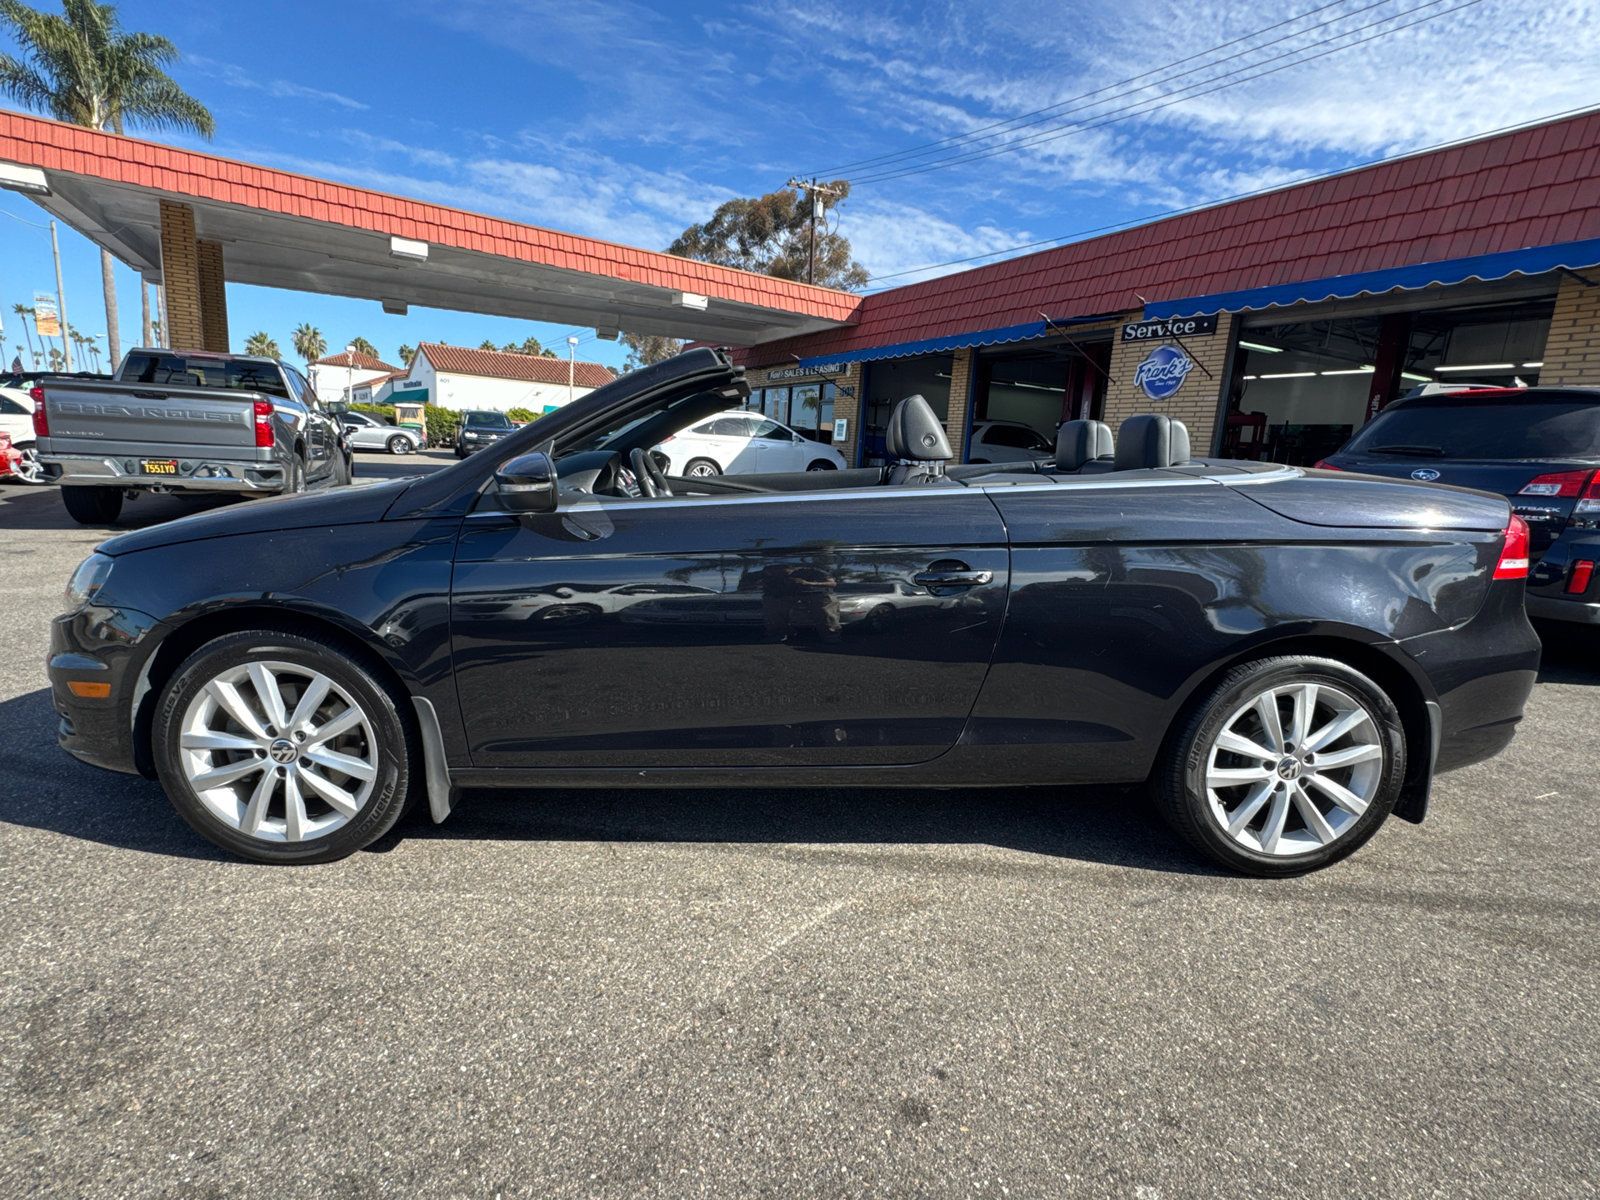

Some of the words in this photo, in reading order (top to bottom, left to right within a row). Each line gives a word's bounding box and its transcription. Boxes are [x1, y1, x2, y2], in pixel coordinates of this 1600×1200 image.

[1124, 320, 1196, 340] Service
[784, 368, 804, 378] SALES
[1133, 357, 1194, 387] Frank's
[57, 401, 241, 423] CHEVROLET
[1512, 505, 1561, 513] UTBACK
